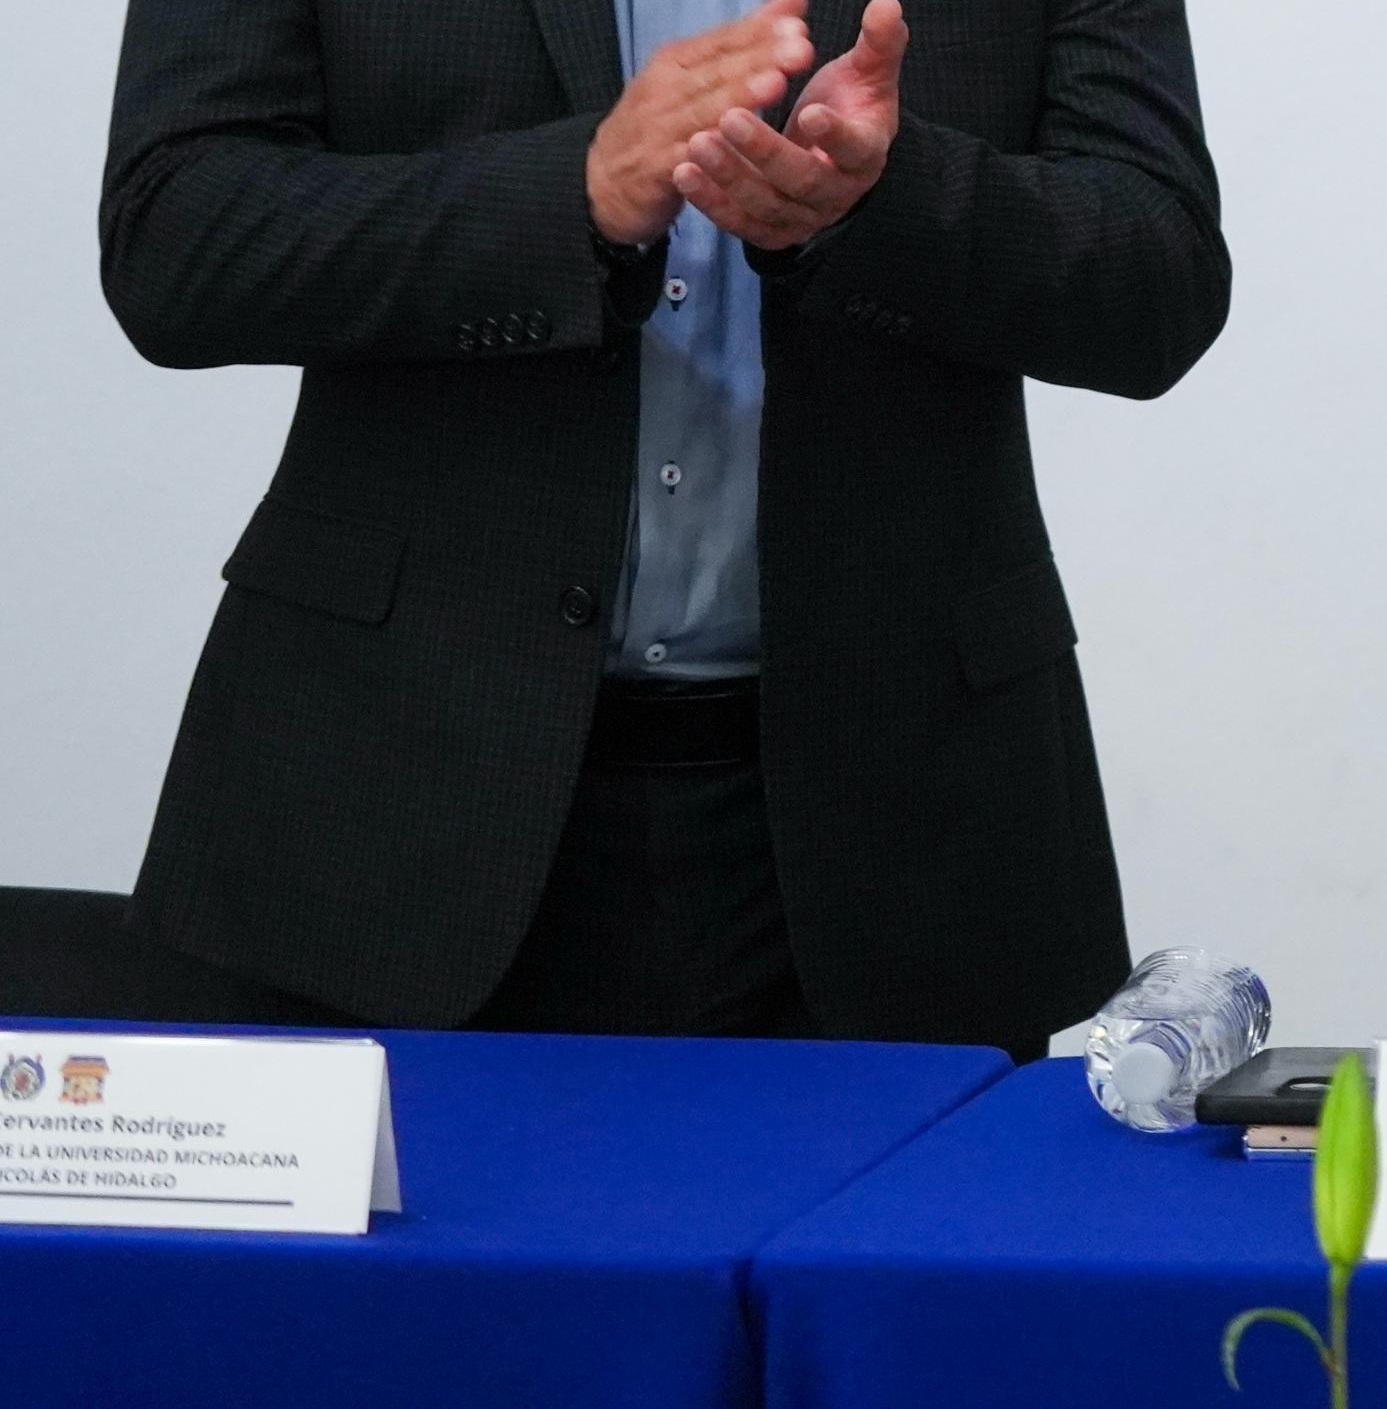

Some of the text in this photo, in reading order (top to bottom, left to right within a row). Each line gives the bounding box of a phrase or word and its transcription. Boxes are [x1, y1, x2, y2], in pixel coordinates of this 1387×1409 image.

[0, 1111, 227, 1141] ervantes Rodríguez
[20, 1143, 41, 1159] LA
[47, 1144, 169, 1164] UNIVERSIDAD
[174, 1148, 300, 1169] MICHOACANA
[67, 1169, 87, 1185] DE
[95, 1171, 177, 1189] HIDALGO
